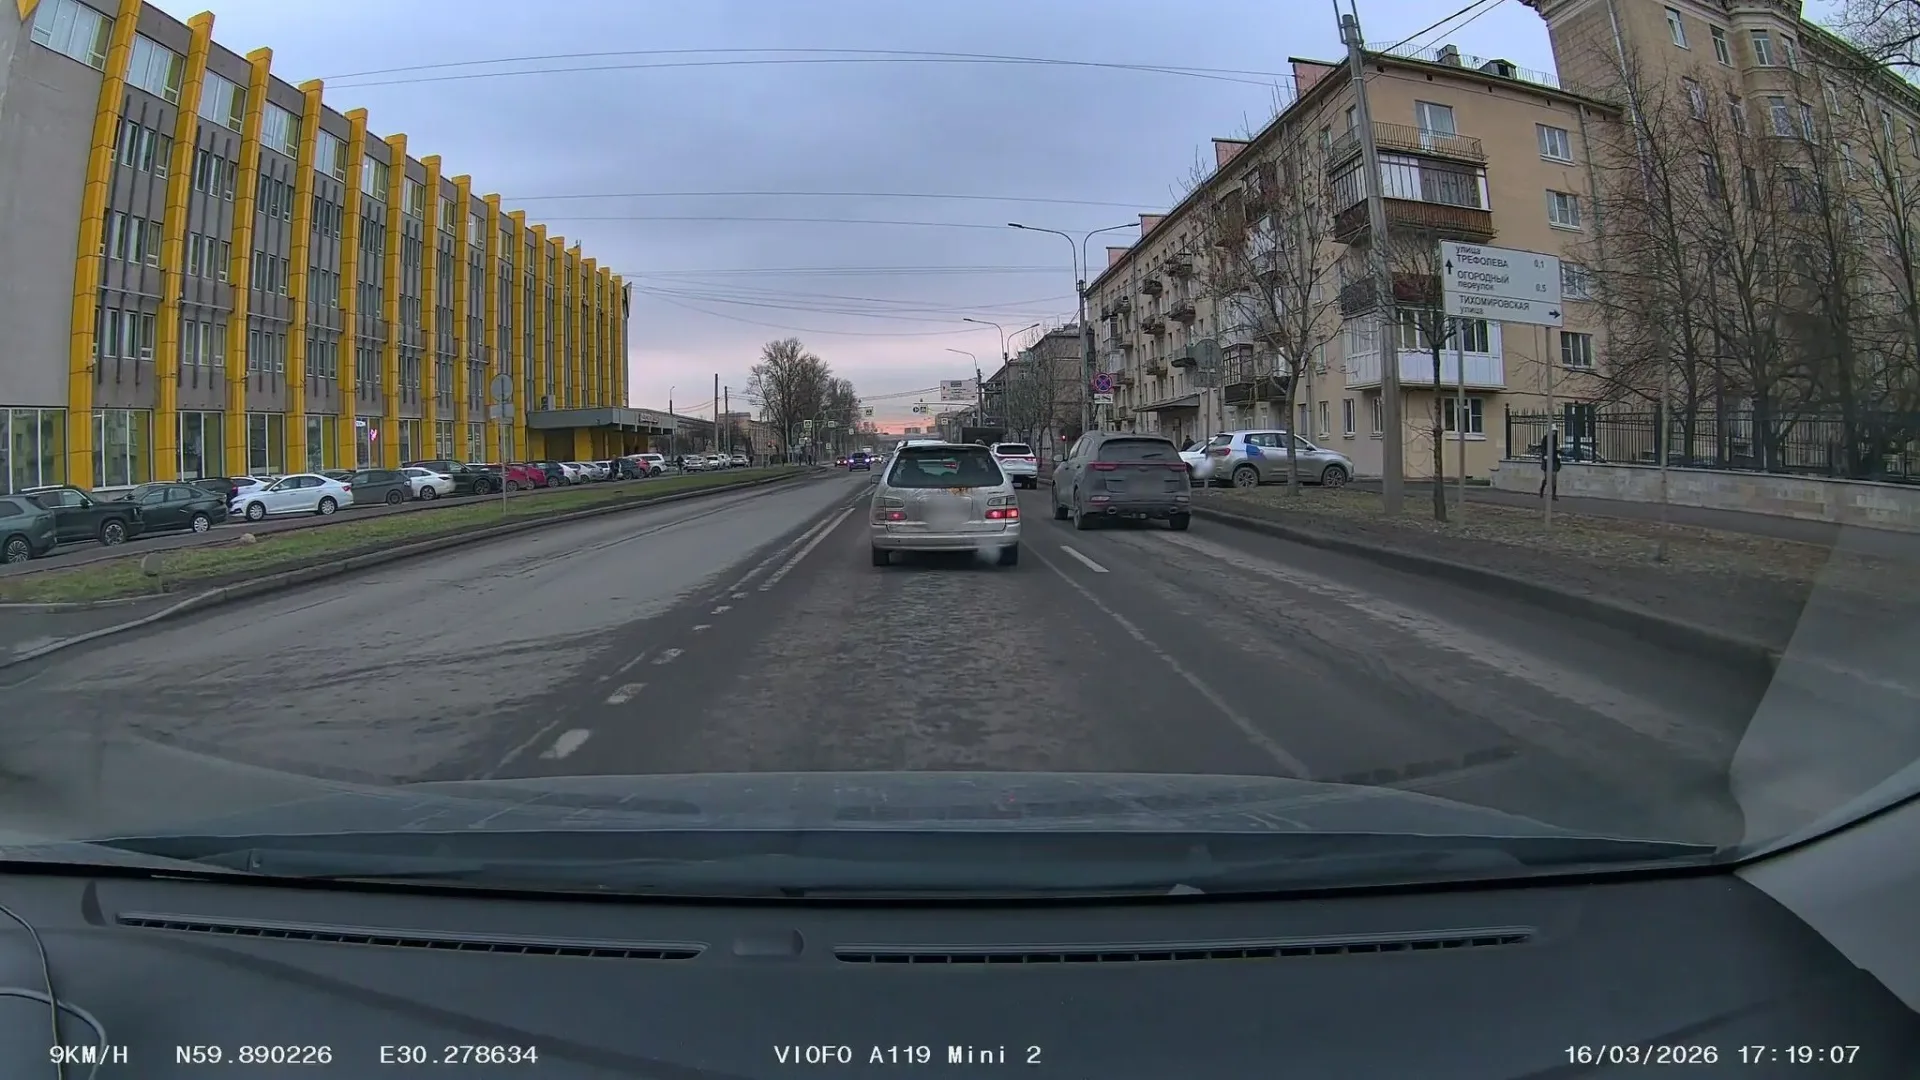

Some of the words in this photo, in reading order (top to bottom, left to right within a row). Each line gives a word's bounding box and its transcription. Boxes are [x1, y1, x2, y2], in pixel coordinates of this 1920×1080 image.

[1455, 245, 1481, 255] улица
[1456, 254, 1509, 268] ТРЕФОЛЕВА
[1457, 270, 1510, 284] ОГОРОДНЫЙ
[1457, 280, 1495, 291] переулок
[1458, 295, 1530, 311] ТИХОМИРОВСКАЯ
[1459, 305, 1484, 315] улица
